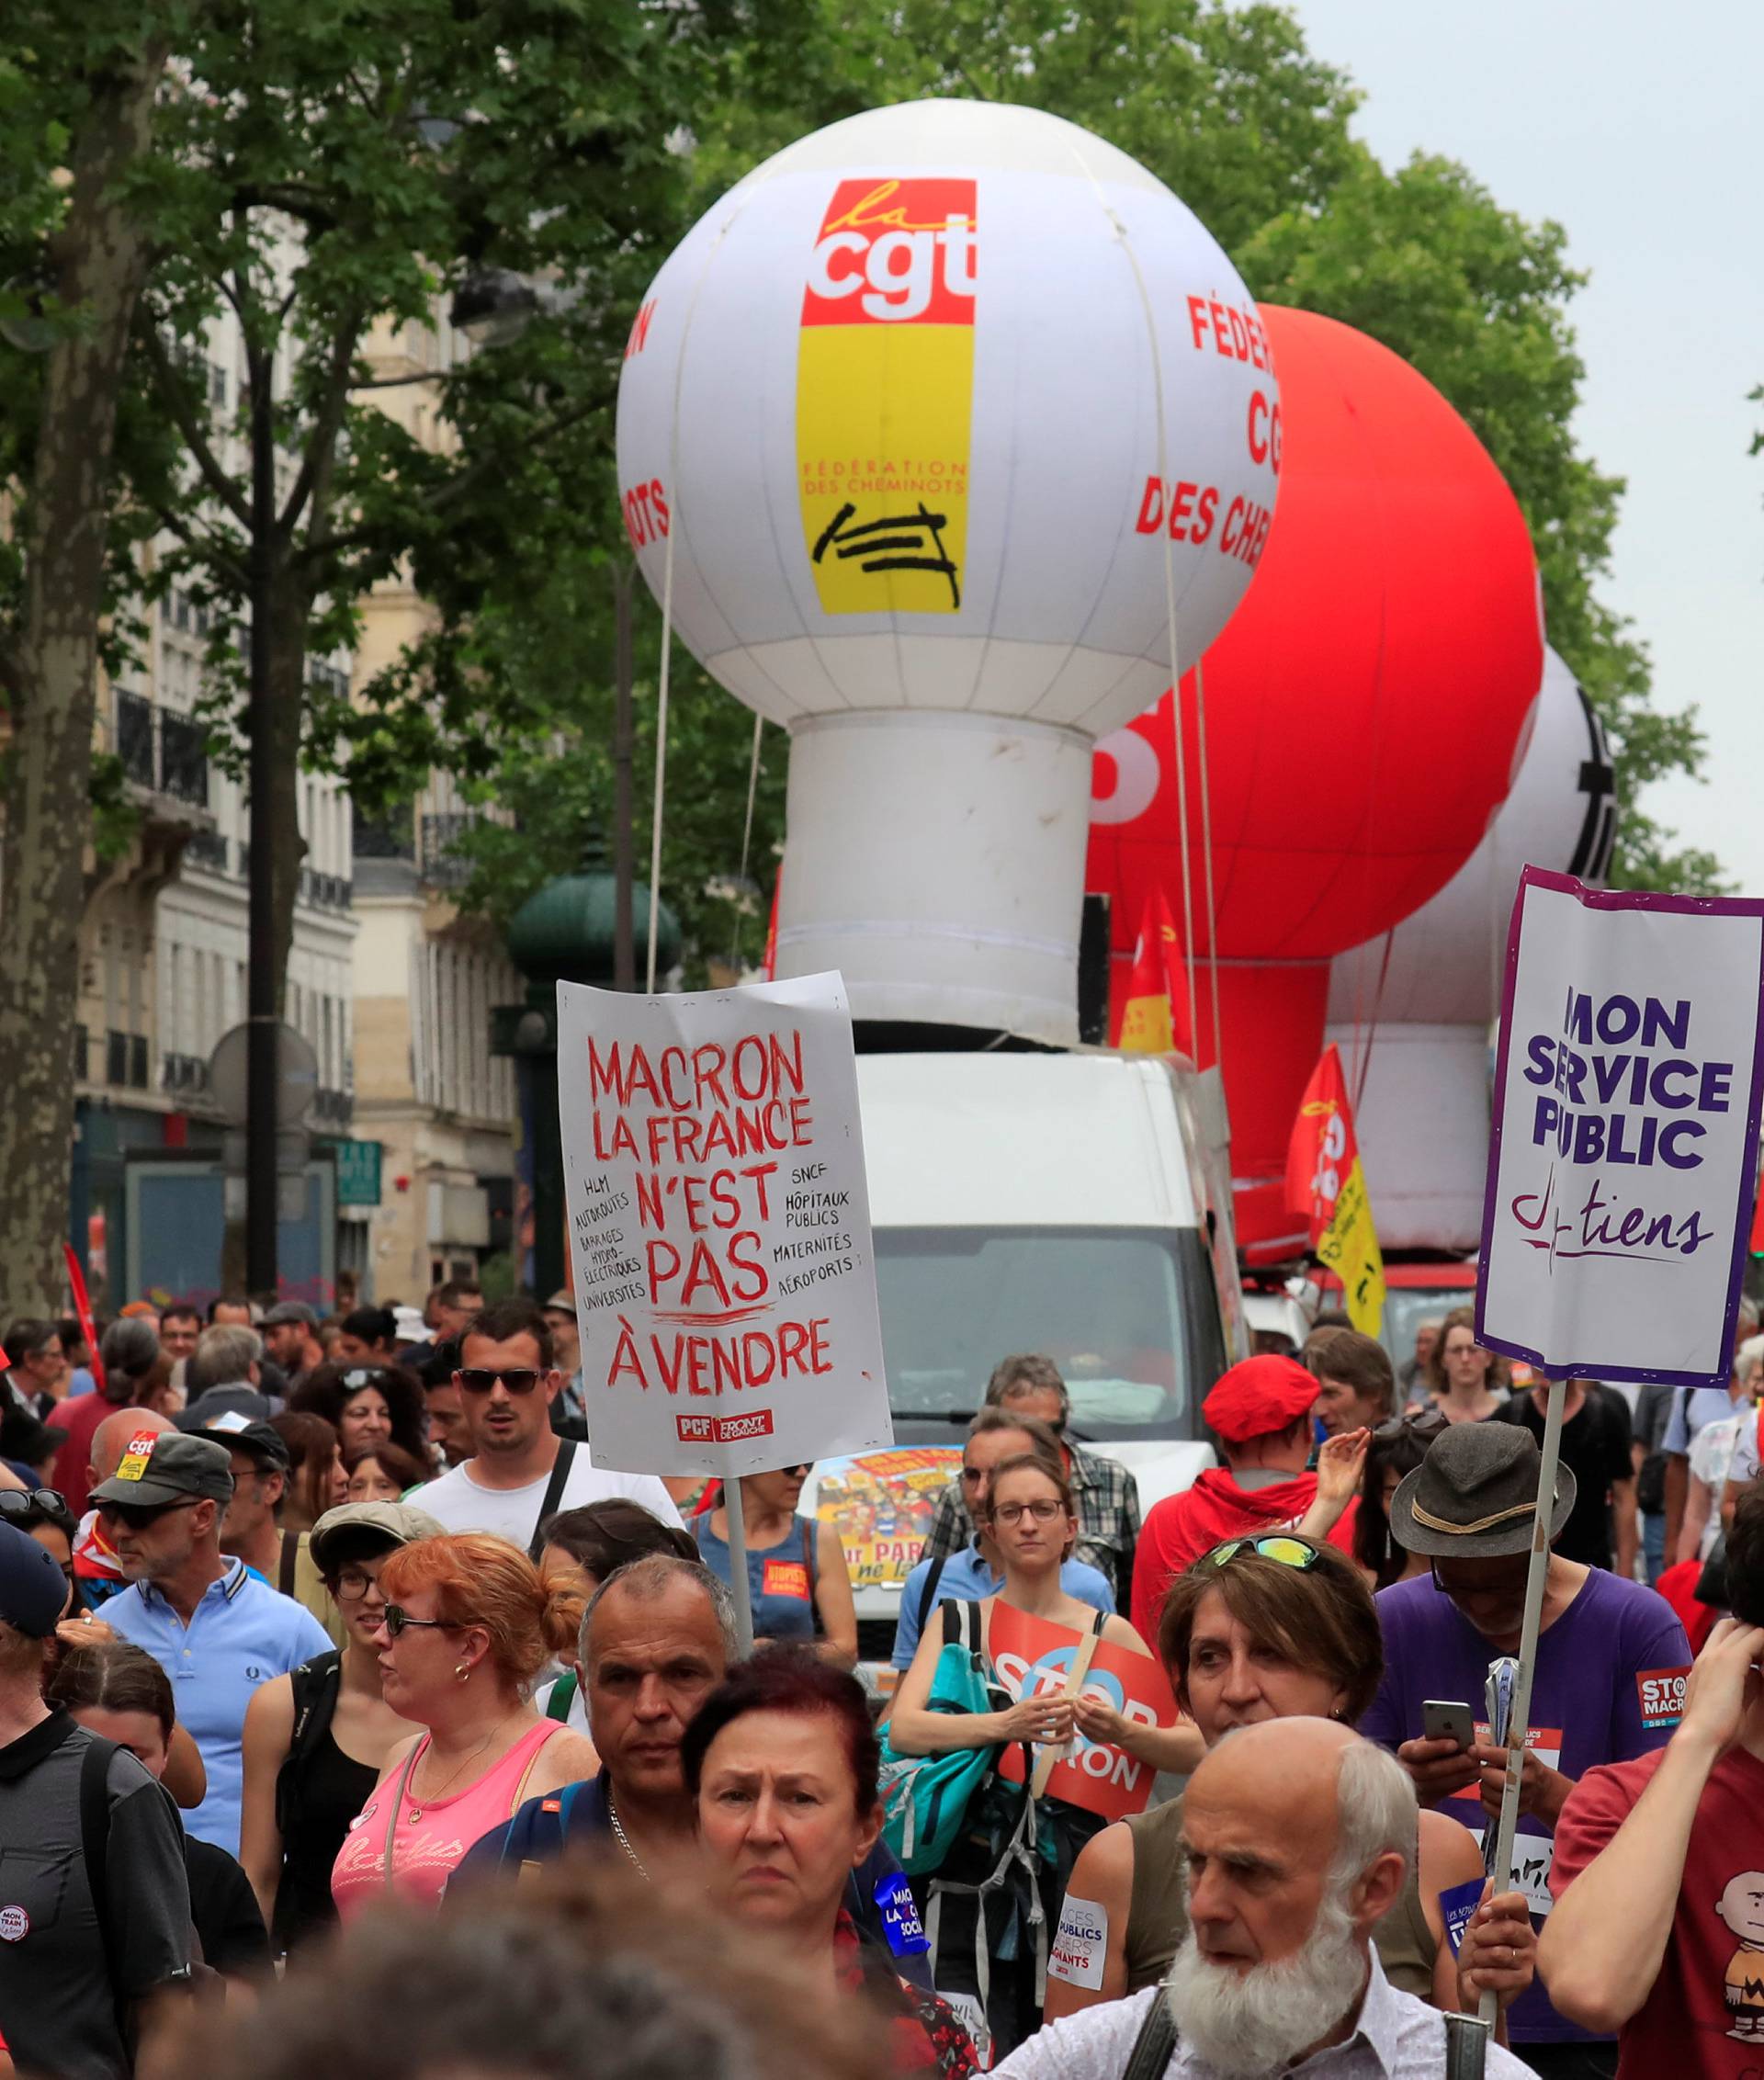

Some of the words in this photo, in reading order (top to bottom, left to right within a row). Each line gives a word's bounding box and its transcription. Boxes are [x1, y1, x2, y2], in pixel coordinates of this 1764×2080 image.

[808, 213, 978, 322] cgt
[802, 458, 967, 476] FÉDÉRATION
[805, 478, 840, 495] DES
[848, 477, 965, 495] CHEMINOTS
[1135, 474, 1220, 547] DES
[1564, 985, 1691, 1050] MON
[587, 1028, 805, 1113] MACRON
[1522, 1034, 1734, 1113] SERVICE
[593, 1109, 641, 1163] LA
[646, 1096, 814, 1168] FRANCE
[1532, 1095, 1707, 1170] PUBLIC
[582, 1174, 610, 1196] HLM
[791, 1163, 827, 1184] SNCF
[635, 1161, 779, 1233] N'EST
[786, 1190, 850, 1211] HÔPITAUX
[786, 1209, 840, 1228] PUBLICS
[1580, 1179, 1714, 1255] tiens
[581, 1227, 625, 1252] BARRAGES
[773, 1232, 853, 1263] MATERNITÉS
[645, 1230, 770, 1308] PAS
[777, 1256, 854, 1297] AÉROPORTS
[582, 1279, 646, 1312] UNIVERSITÉS
[607, 1314, 649, 1392] À
[649, 1317, 834, 1396] VENDRE
[681, 1418, 710, 1436] PCF
[719, 1415, 765, 1432] FRONT
[720, 1431, 731, 1441] DE
[731, 1424, 765, 1438] GAUCHE
[130, 1439, 155, 1455] cgt
[1642, 1676, 1687, 1701] STO
[1644, 1697, 1685, 1715] MACR
[1, 1918, 22, 1927] TRAIN
[3, 1911, 21, 1920] MON
[885, 1908, 902, 1924] LA
